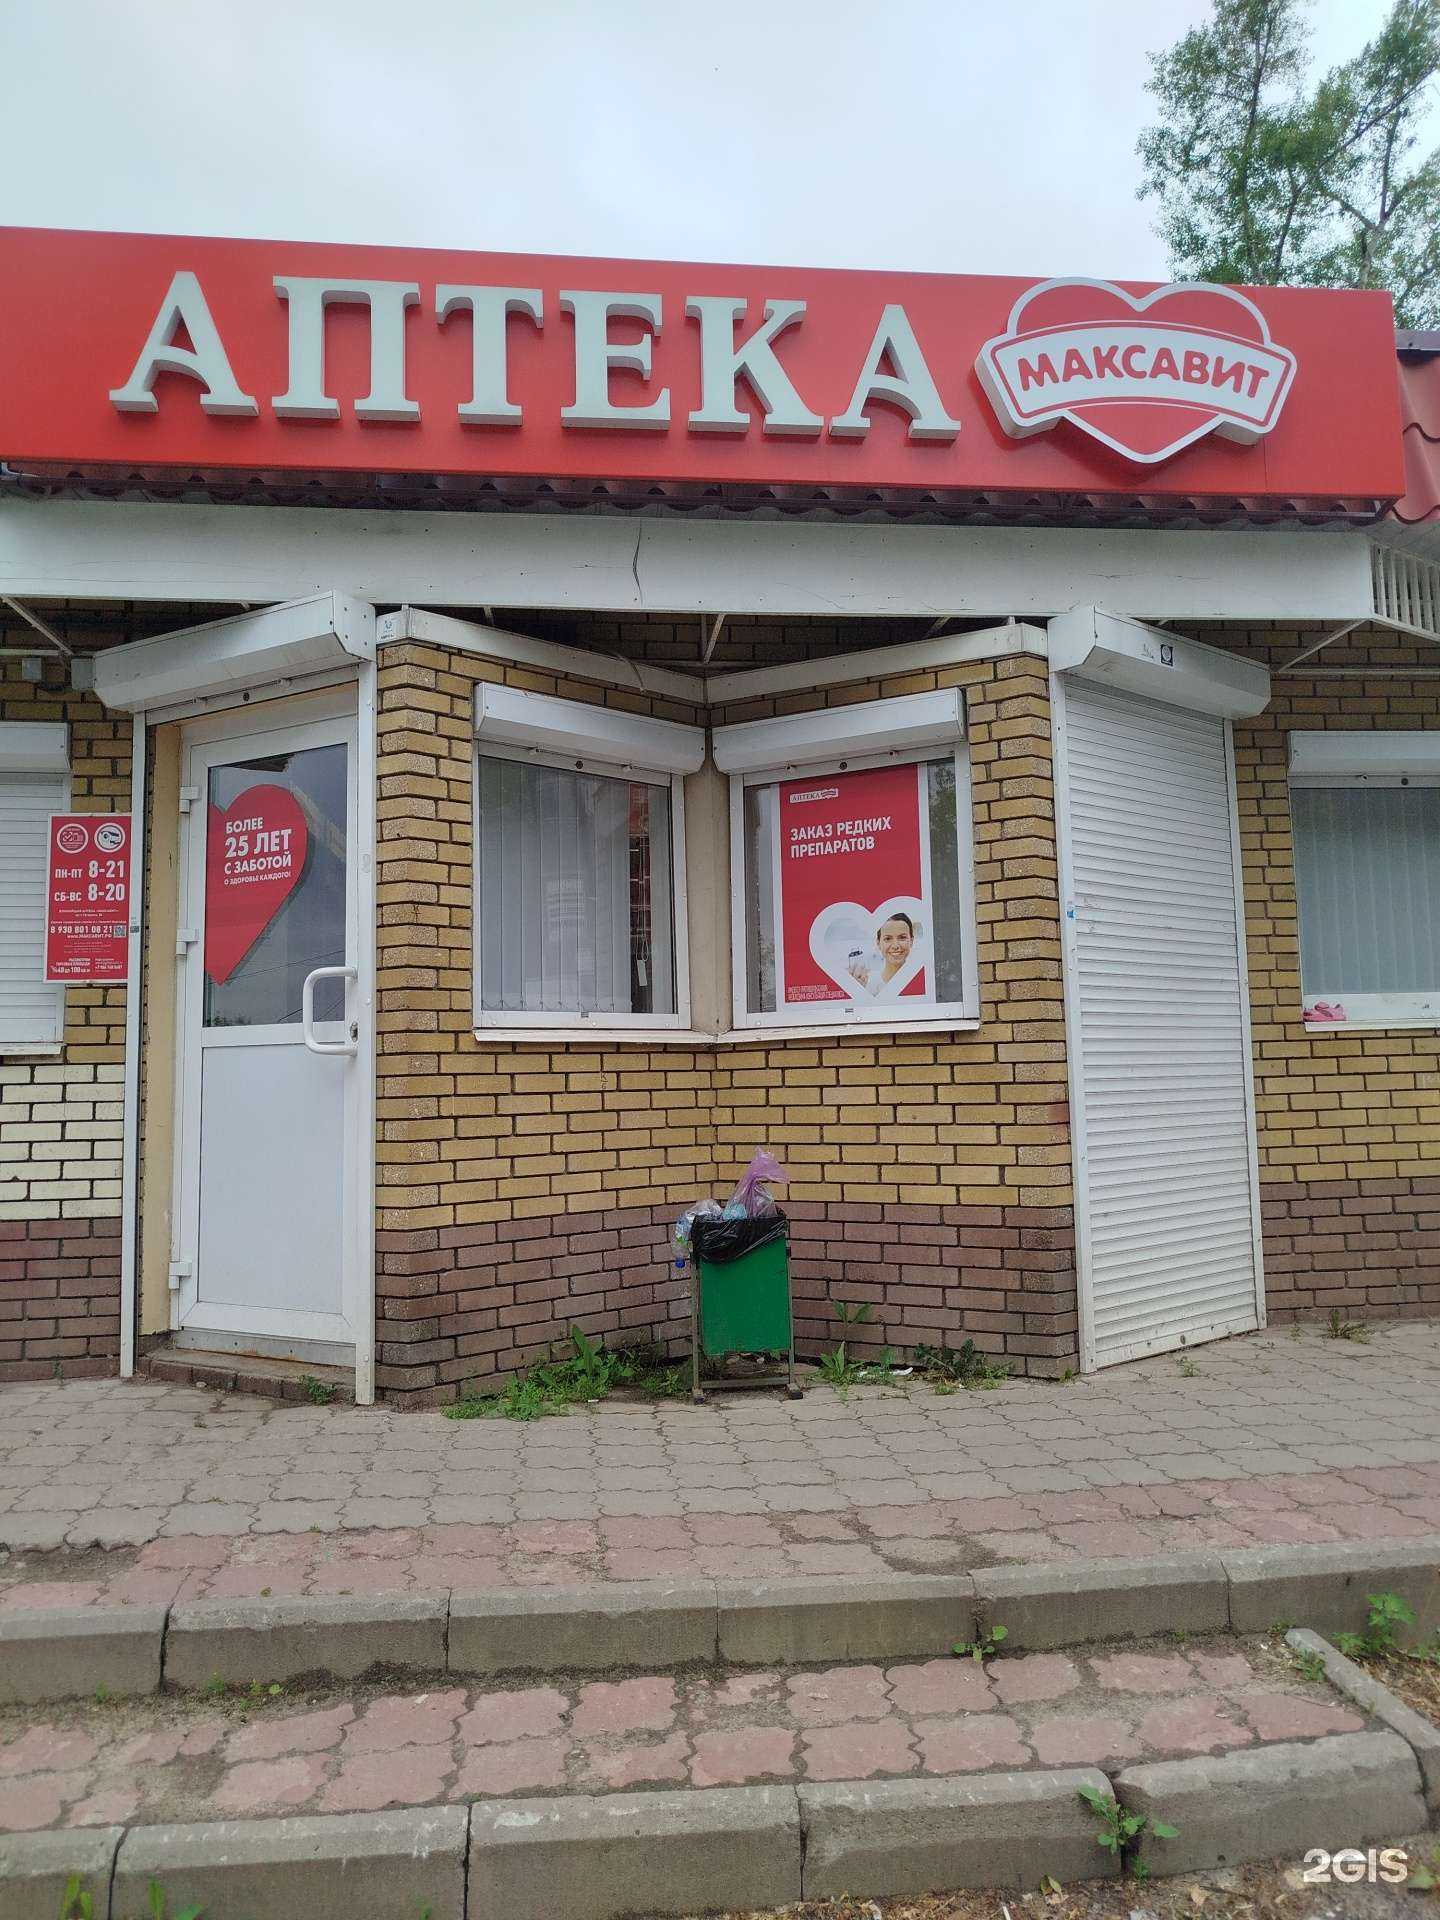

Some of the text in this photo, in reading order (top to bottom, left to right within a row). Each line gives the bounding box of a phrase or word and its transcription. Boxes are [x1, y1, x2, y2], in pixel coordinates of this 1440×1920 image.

[109, 270, 961, 440] АПТЕКА
[1017, 343, 1270, 398] МАКСАВИТ
[226, 816, 263, 834] БОЛЕЕ
[790, 816, 892, 841] ЗАКАЗ РЕДКИХ
[225, 828, 292, 858] 25 ЛЕТ
[791, 836, 875, 858] ПРЕПАРАТОВ
[55, 860, 125, 879] ПН-ПТ 8-21
[224, 851, 292, 875] С ЗАБОТОЙ
[54, 883, 125, 902] СБ-ВС 8-20
[103, 925, 112, 933] 21
